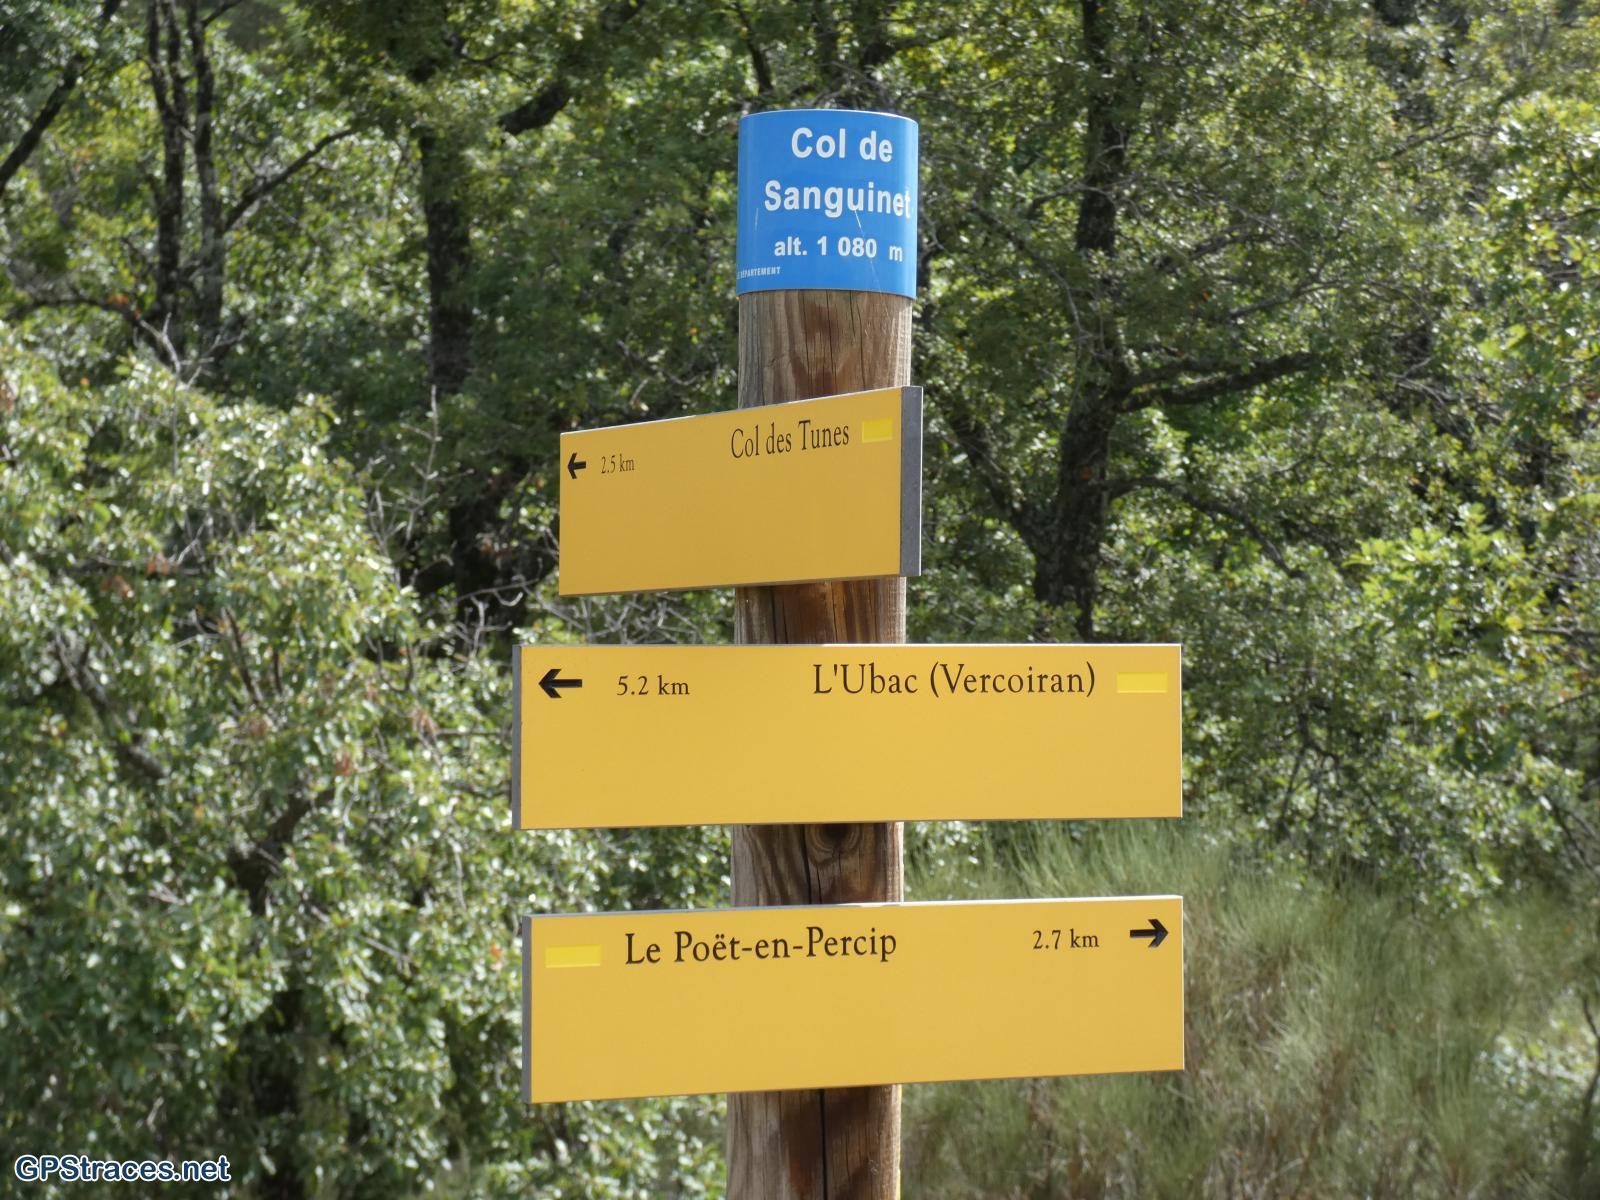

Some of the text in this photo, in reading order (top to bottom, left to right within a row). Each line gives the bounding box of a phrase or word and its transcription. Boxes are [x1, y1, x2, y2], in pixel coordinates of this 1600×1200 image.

[791, 127, 893, 162] Col de
[764, 180, 911, 219] Sanguinet
[774, 236, 903, 262] alt. 1 080 m
[731, 419, 850, 459] Col des Tunes
[600, 454, 635, 474] 2.5 km
[616, 675, 691, 697] 5.2 km
[812, 661, 1096, 698] L'Ubac (Vercoiran)
[625, 926, 897, 965] Le Poët-en-Percip
[1032, 928, 1100, 950] 2.7 km
